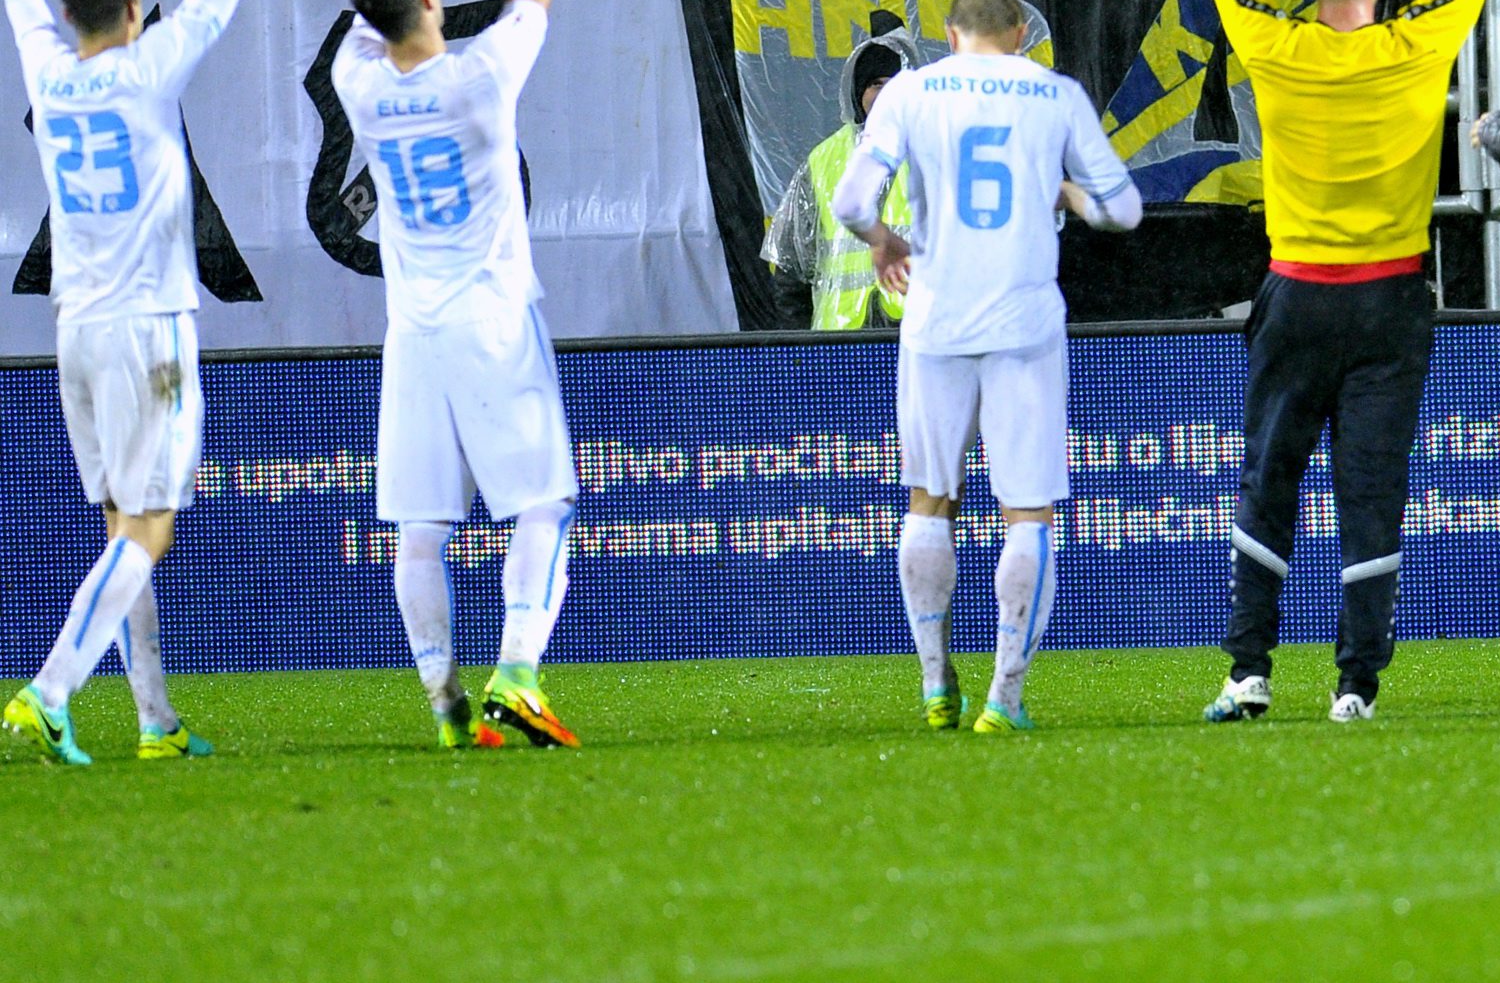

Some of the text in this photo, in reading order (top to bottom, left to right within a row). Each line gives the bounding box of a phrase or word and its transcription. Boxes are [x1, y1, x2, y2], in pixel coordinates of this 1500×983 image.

[377, 96, 441, 117] ELEZ
[924, 76, 1058, 100] RISTOVSKI
[47, 110, 140, 214] 23
[378, 136, 472, 230] 18
[957, 125, 1013, 230] 6
[238, 449, 378, 503] upotr
[701, 433, 902, 490] pročitaj
[1170, 423, 1246, 477] lije
